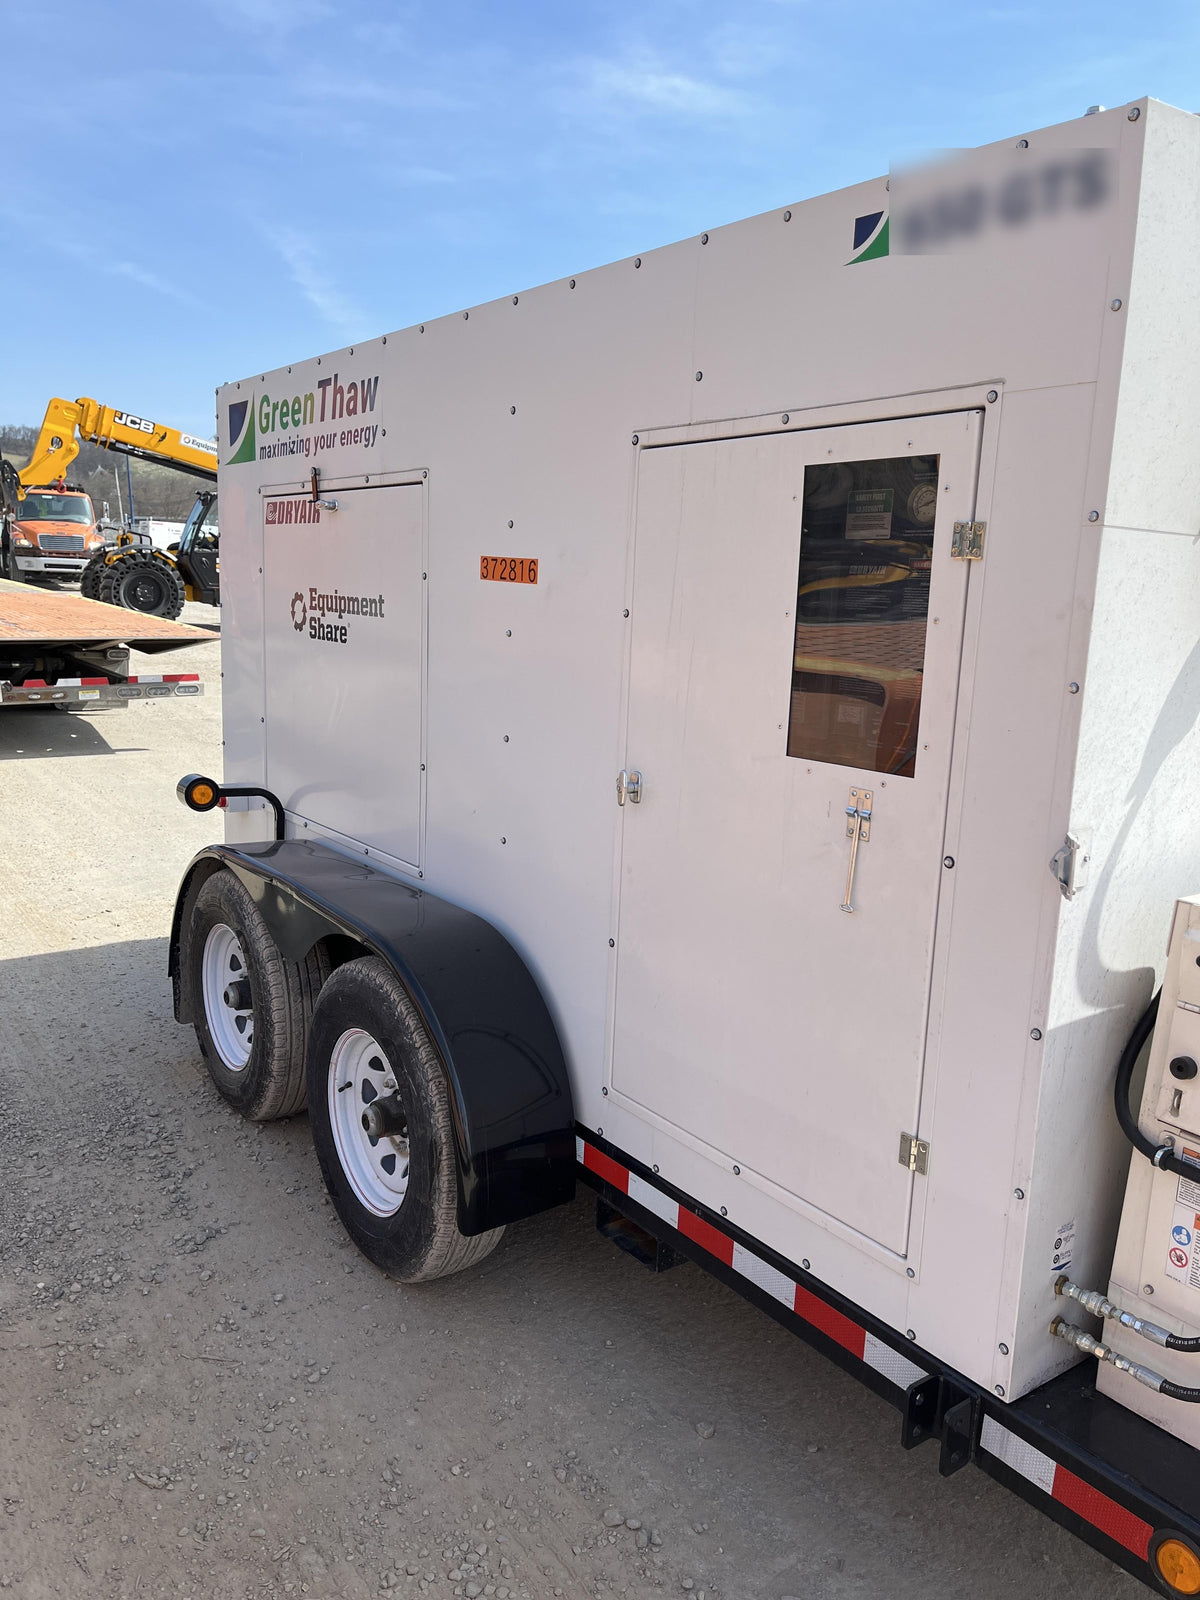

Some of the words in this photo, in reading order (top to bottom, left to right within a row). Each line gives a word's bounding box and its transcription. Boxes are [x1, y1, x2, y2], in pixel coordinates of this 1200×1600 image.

[114, 412, 154, 434] JCB
[259, 435, 311, 460] maximizing
[313, 432, 338, 457] your
[340, 424, 379, 449] energy
[277, 499, 321, 525] DRYAIR
[481, 557, 537, 583] 372816
[308, 587, 385, 619] Equipment
[309, 616, 348, 644] Share
